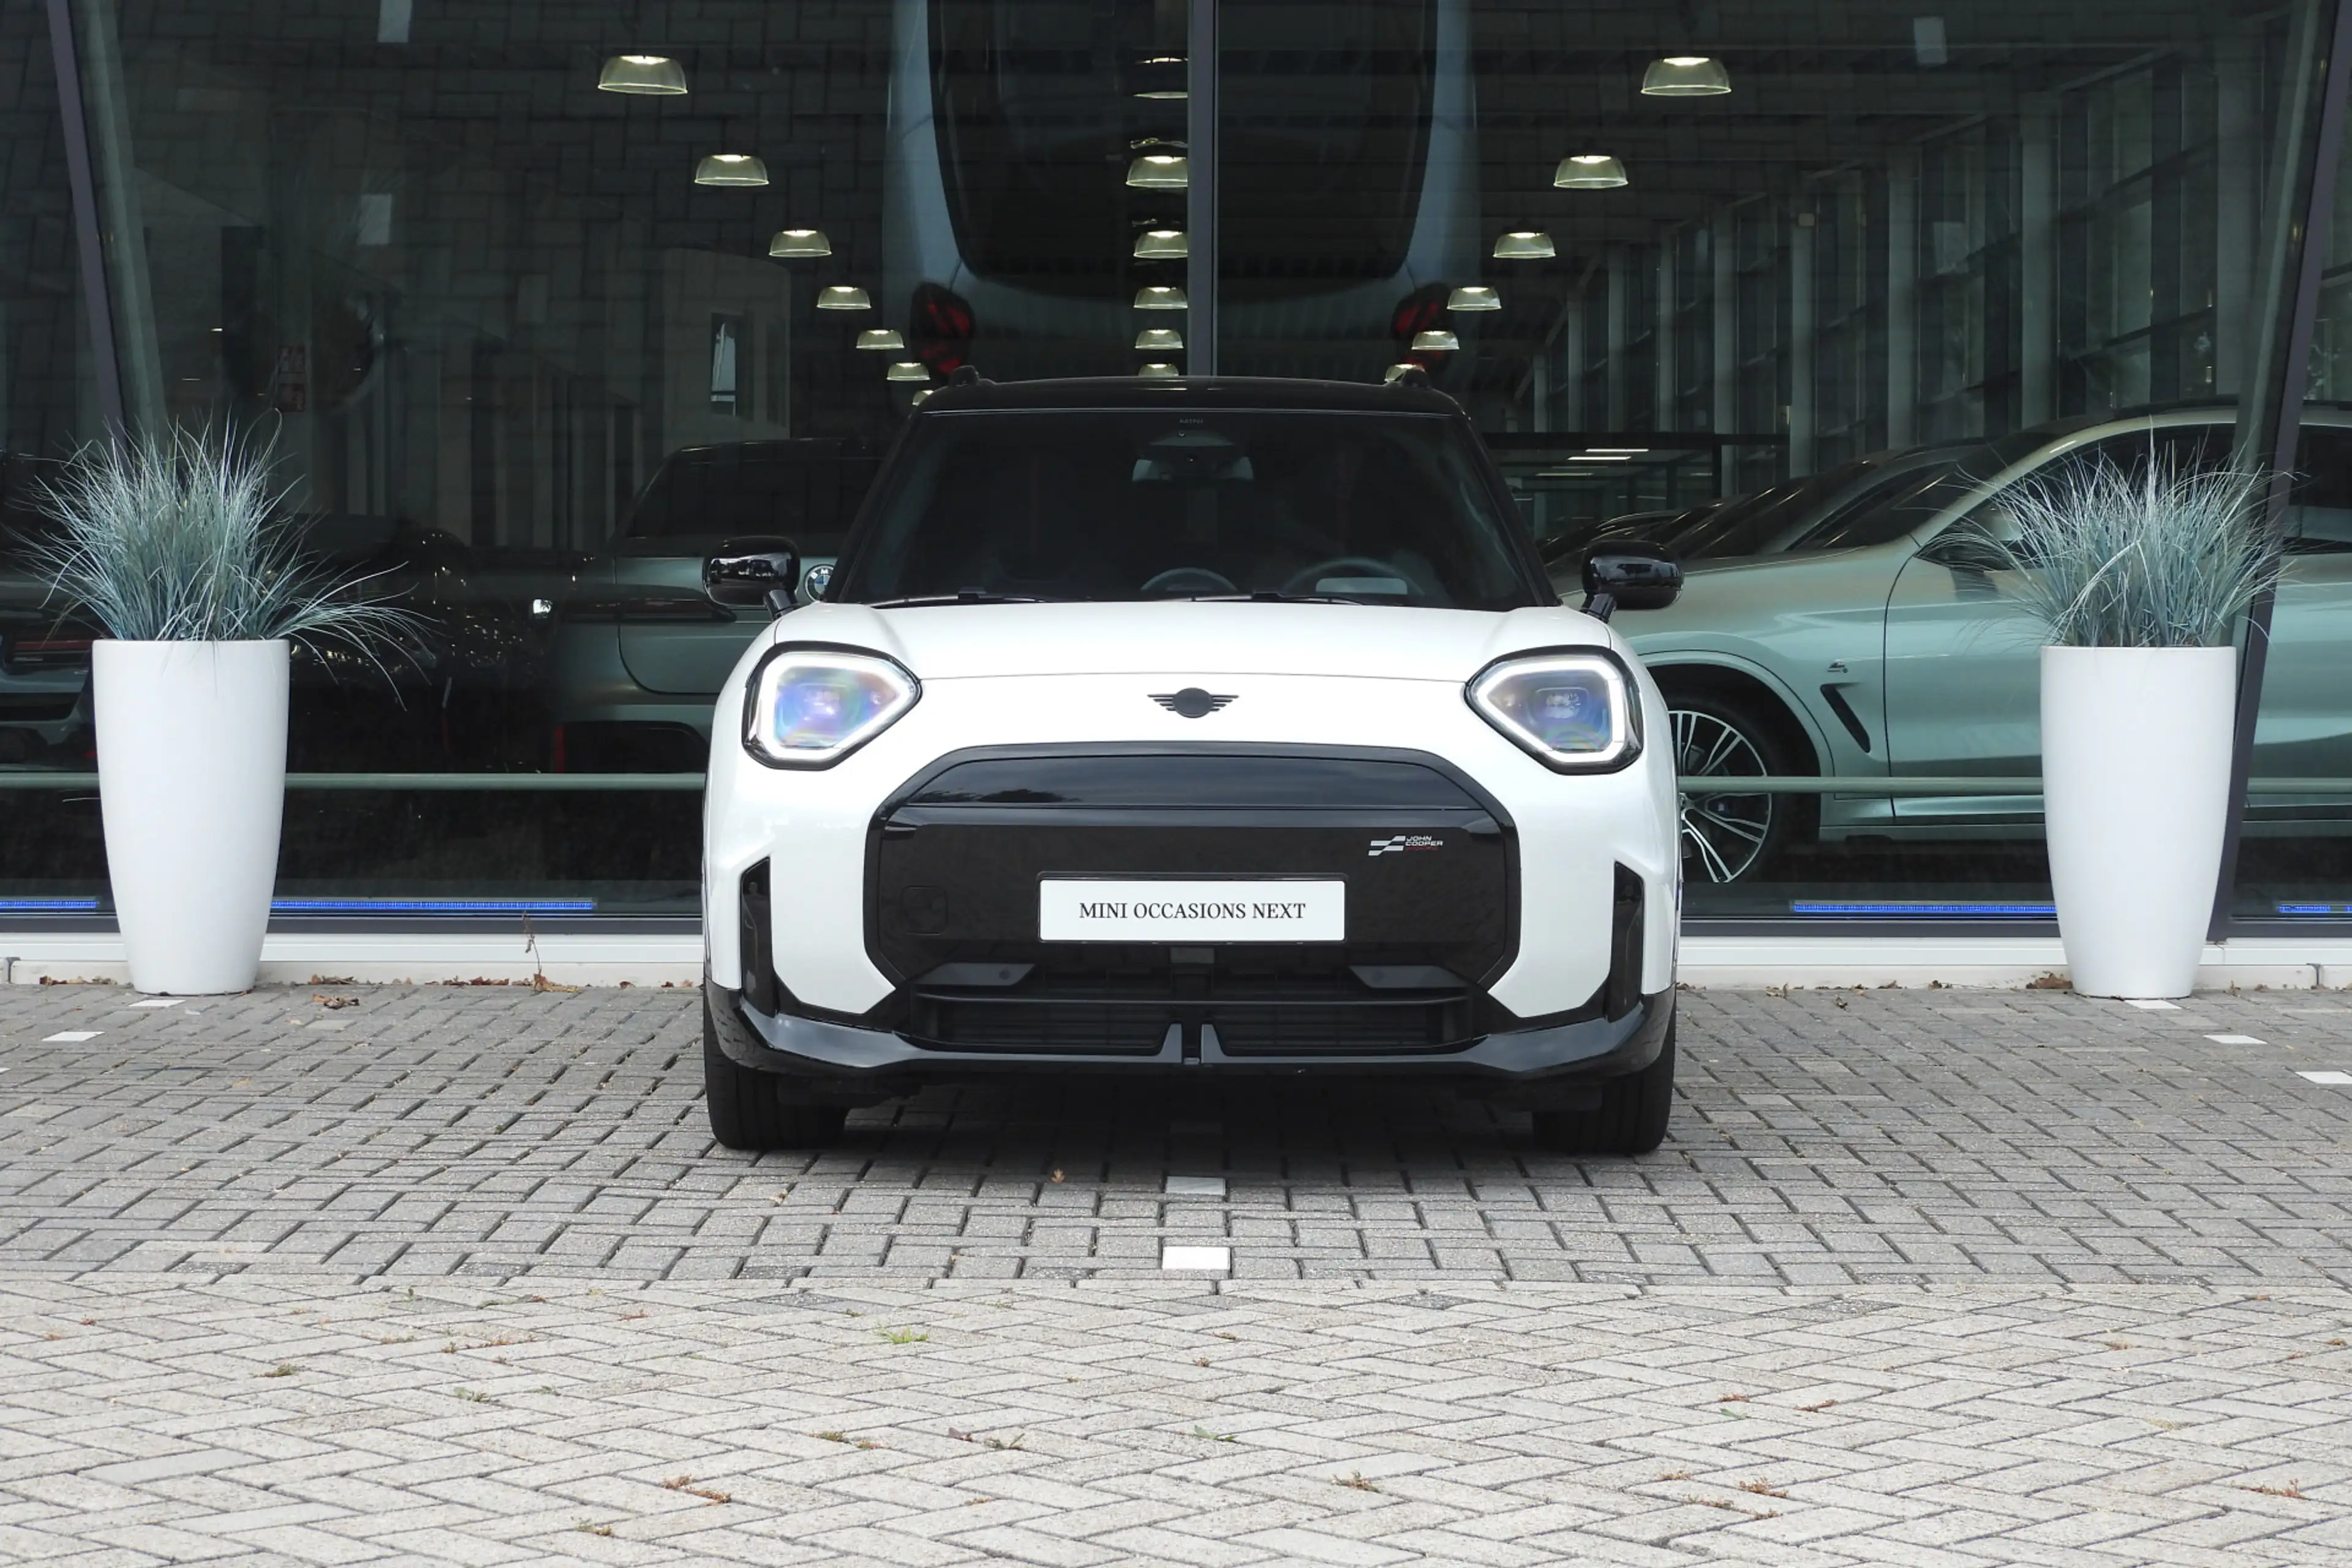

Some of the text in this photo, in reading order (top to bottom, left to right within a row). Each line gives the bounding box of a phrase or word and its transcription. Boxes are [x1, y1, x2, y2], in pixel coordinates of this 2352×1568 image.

[1080, 903, 1306, 919] MINI OCCASIONS NEXT
